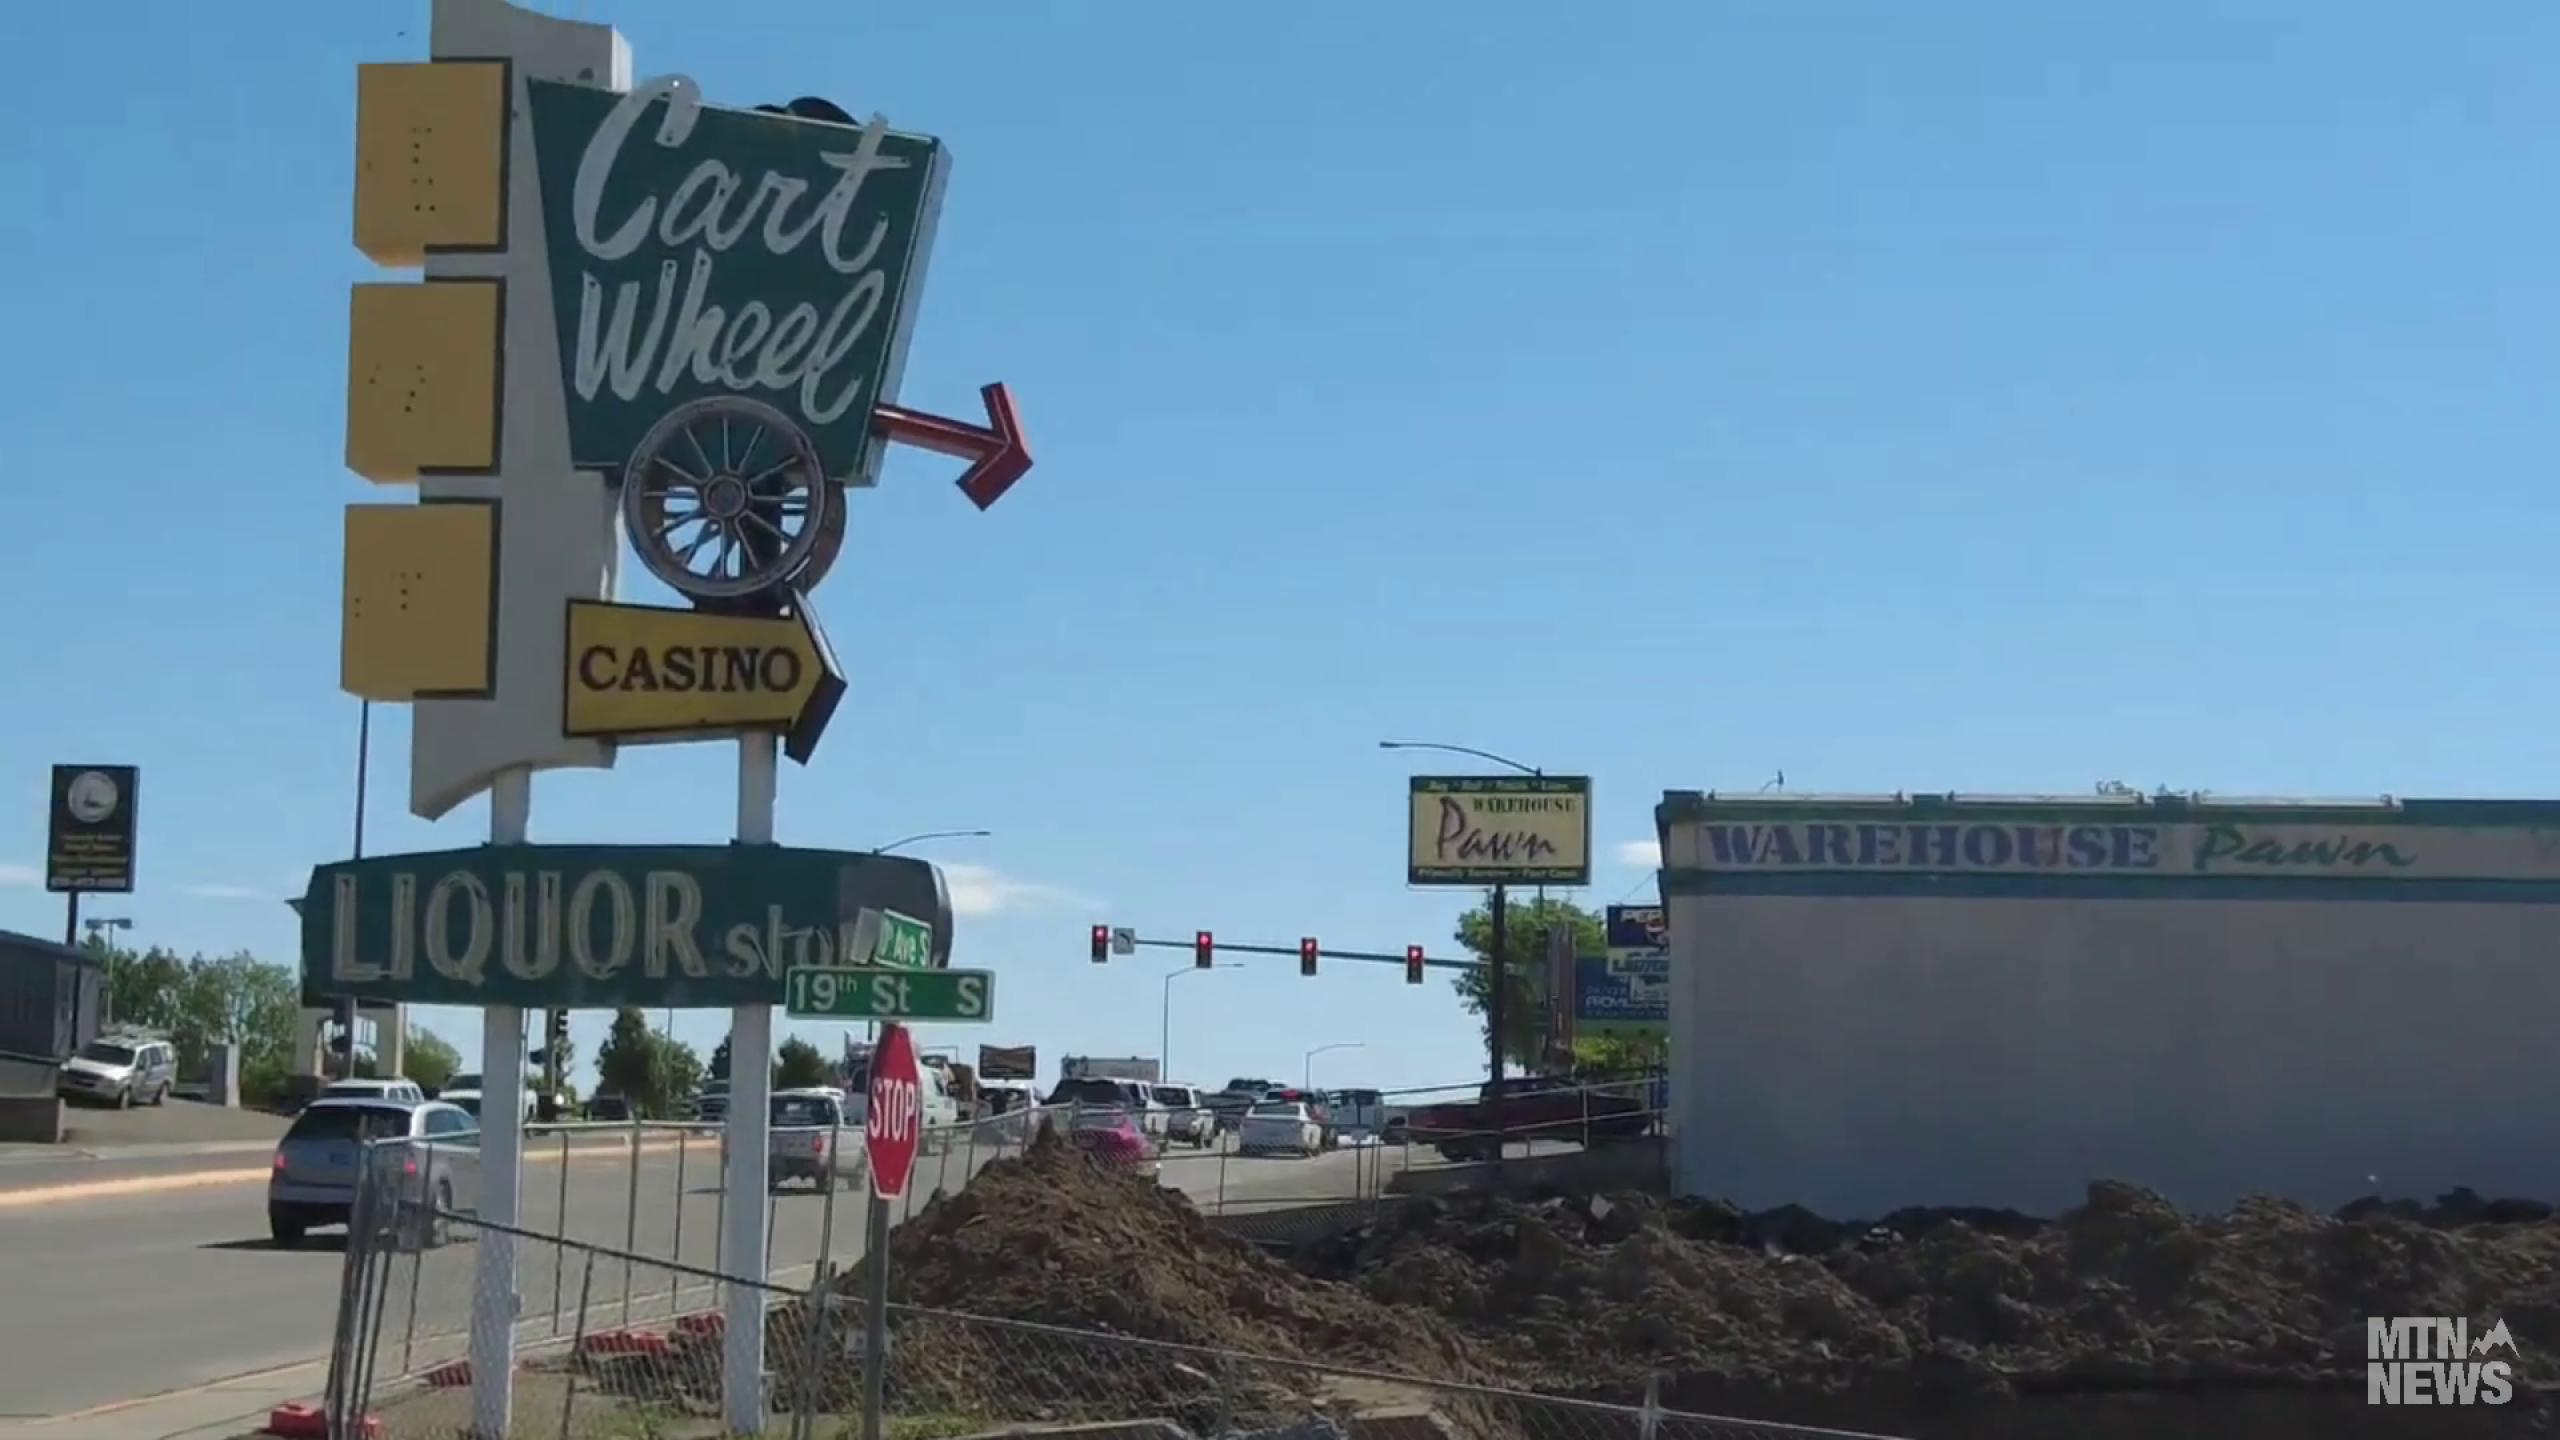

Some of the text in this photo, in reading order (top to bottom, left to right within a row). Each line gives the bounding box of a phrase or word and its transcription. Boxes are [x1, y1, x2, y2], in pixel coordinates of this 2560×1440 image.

[573, 73, 910, 273] Cart
[575, 248, 885, 424] Wheel
[579, 644, 803, 693] CASINO
[1437, 795, 1557, 861] Pawn
[1473, 797, 1576, 813] WAREHOUSE
[1704, 823, 2418, 872] WAREHOUSE Pawn
[332, 870, 707, 986] LIQUOR
[795, 972, 983, 1016] 19th St S
[869, 1077, 915, 1142] STOP
